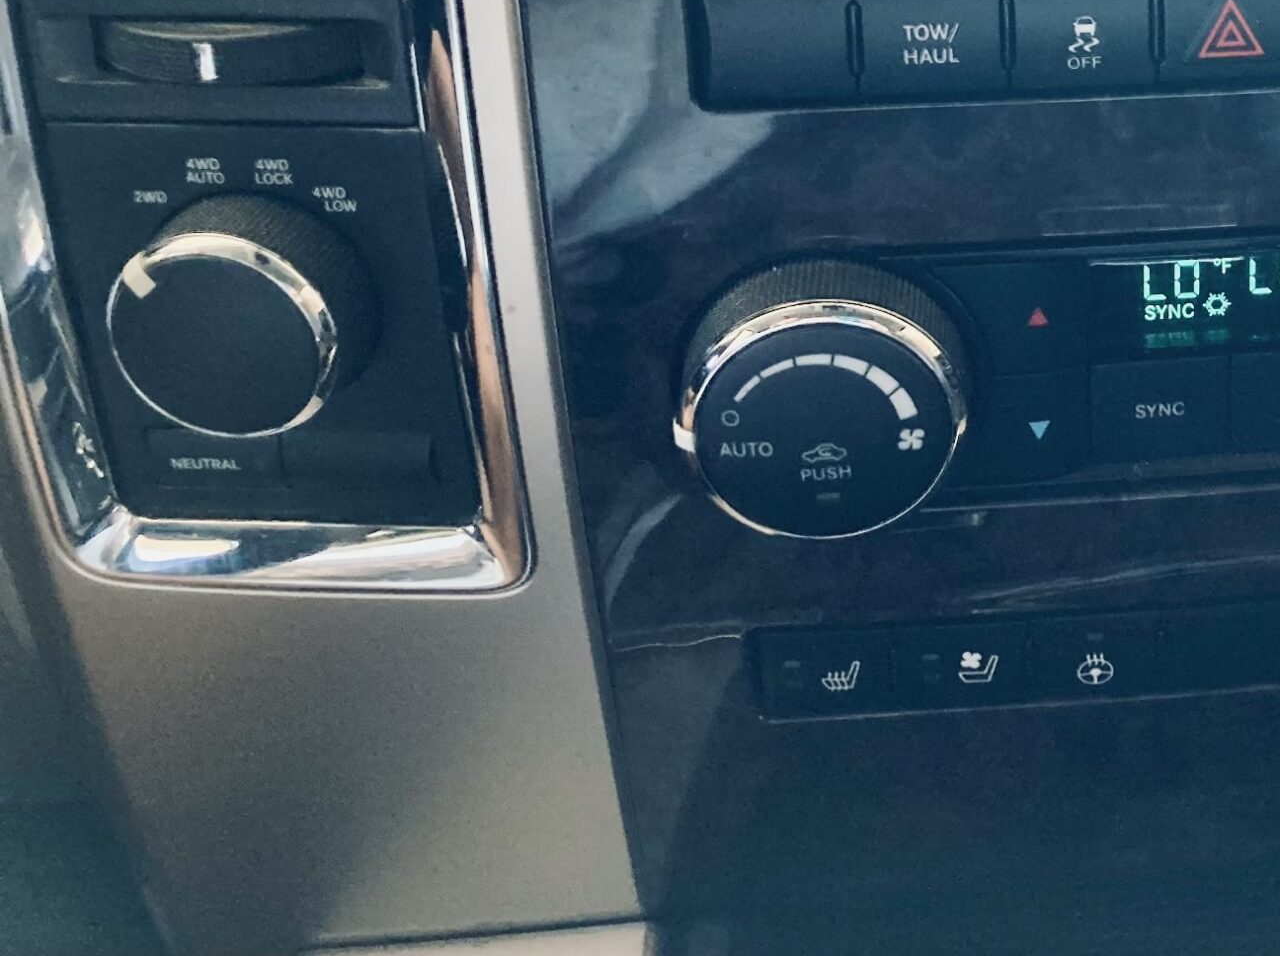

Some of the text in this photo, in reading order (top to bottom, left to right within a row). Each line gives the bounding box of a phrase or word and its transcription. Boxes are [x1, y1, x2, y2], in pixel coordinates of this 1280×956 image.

[903, 23, 960, 43] TOW/
[903, 48, 960, 65] HAUL
[1066, 56, 1102, 70] OFF
[185, 157, 221, 171] 4WD
[255, 159, 289, 171] 4WD
[185, 171, 225, 185] AUTO
[255, 172, 294, 185] LOCK
[133, 190, 168, 204] 2WD
[312, 186, 346, 200] 4WD
[324, 200, 358, 213] LOW
[1143, 259, 1200, 301] LO
[1144, 302, 1196, 321] SYNC
[1135, 401, 1186, 419] SYNC
[720, 442, 774, 458] AUTO
[170, 457, 241, 471] NEUTRAL
[800, 466, 852, 482] PUSH
